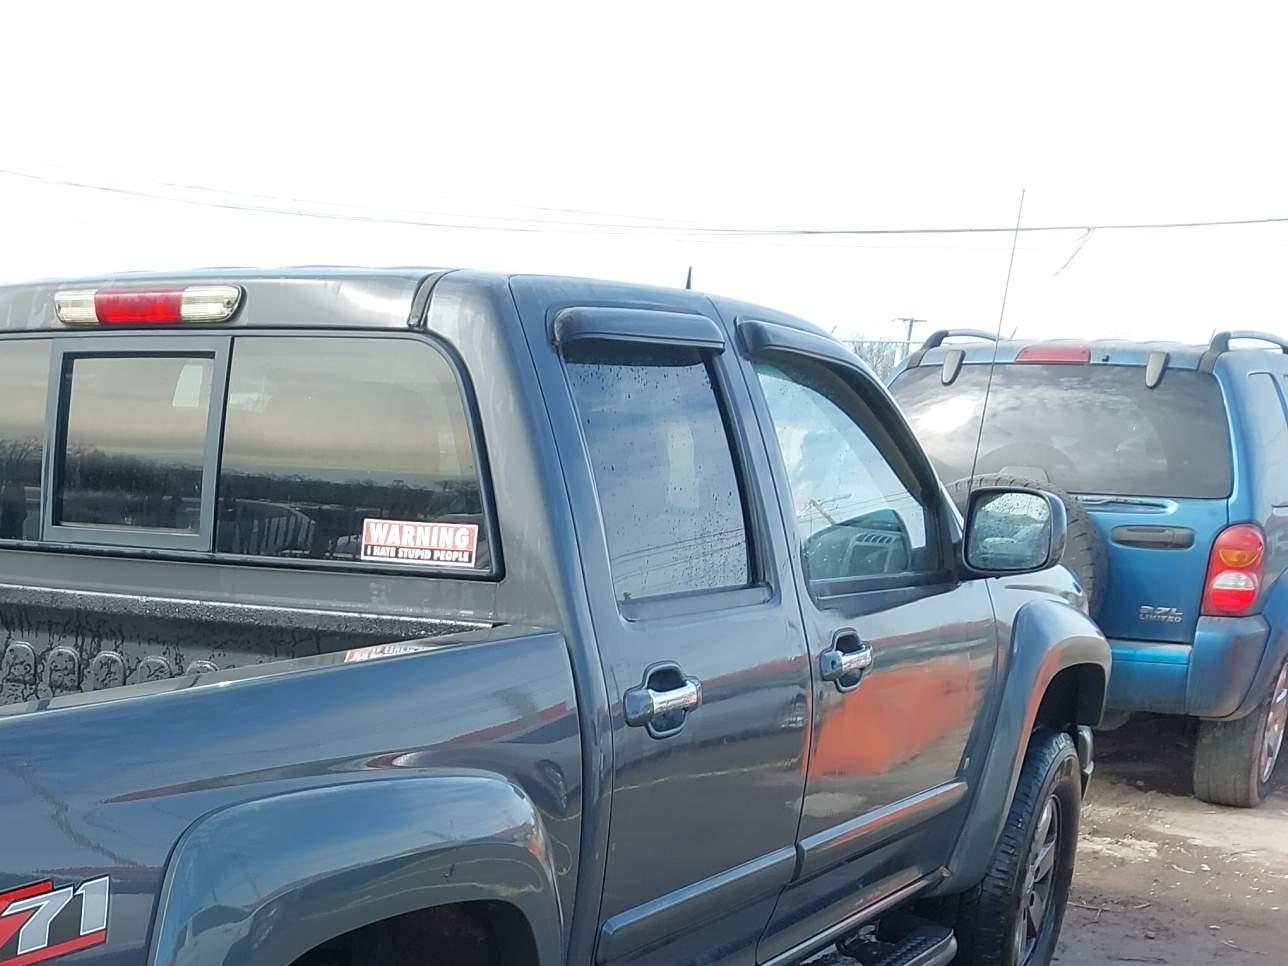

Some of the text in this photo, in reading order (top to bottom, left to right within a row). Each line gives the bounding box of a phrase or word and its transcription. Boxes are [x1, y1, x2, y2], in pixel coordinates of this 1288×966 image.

[369, 522, 470, 547] WARNING
[372, 546, 397, 558] HATE
[397, 547, 432, 560] STUPID
[433, 550, 470, 562] PEOPLE
[1139, 613, 1183, 623] LIMITED
